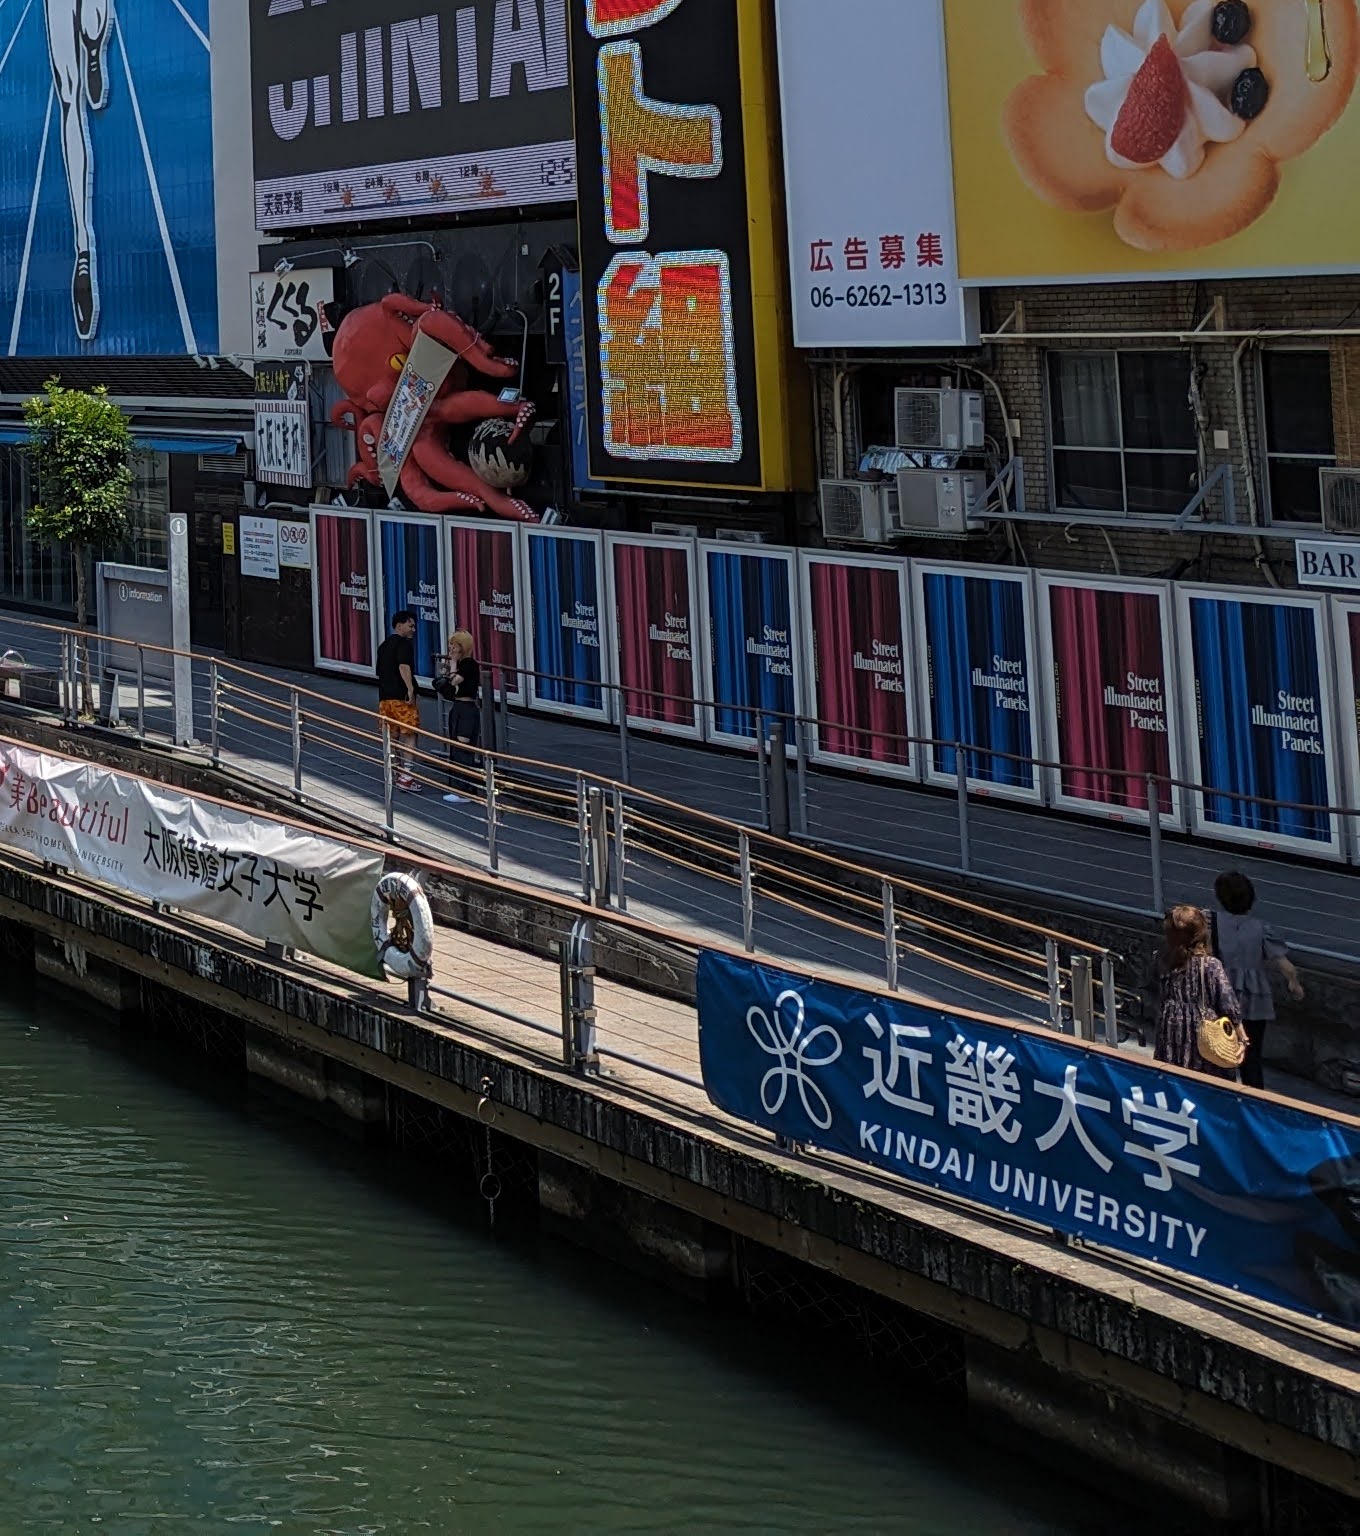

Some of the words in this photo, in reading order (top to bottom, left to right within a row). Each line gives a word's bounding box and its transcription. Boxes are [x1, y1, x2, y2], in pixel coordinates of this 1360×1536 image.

[808, 232, 944, 274] 広告募集
[809, 281, 948, 309] 06-6262-1313
[1301, 550, 1357, 579] BAR
[128, 587, 163, 603] information
[418, 579, 437, 595] Street
[491, 588, 512, 605] Street
[575, 600, 596, 617] Street
[560, 610, 598, 632] Illuminated
[664, 611, 687, 630] Street
[576, 628, 600, 648] Panels.
[648, 623, 690, 645] Illuminated
[763, 623, 788, 644] Street
[666, 641, 692, 661] Panels.
[746, 636, 791, 659] Illuminated
[871, 637, 900, 659] Street
[764, 655, 794, 677] Panels.
[853, 653, 902, 676] Illuminated
[992, 653, 1023, 676] Street
[873, 672, 905, 695] Panels.
[972, 667, 1026, 694] Illuminated
[1126, 670, 1160, 695] Street
[995, 689, 1030, 713] Panels.
[1104, 686, 1164, 714] Illuminated
[1277, 689, 1315, 714] Street
[1129, 709, 1168, 734] Panels.
[1251, 706, 1321, 735] Illuminated
[1280, 730, 1326, 757] Panels.
[861, 1012, 1201, 1193] 近畿大学
[859, 1119, 976, 1184] KINDAI
[989, 1160, 1209, 1260] UNIVERSITY
